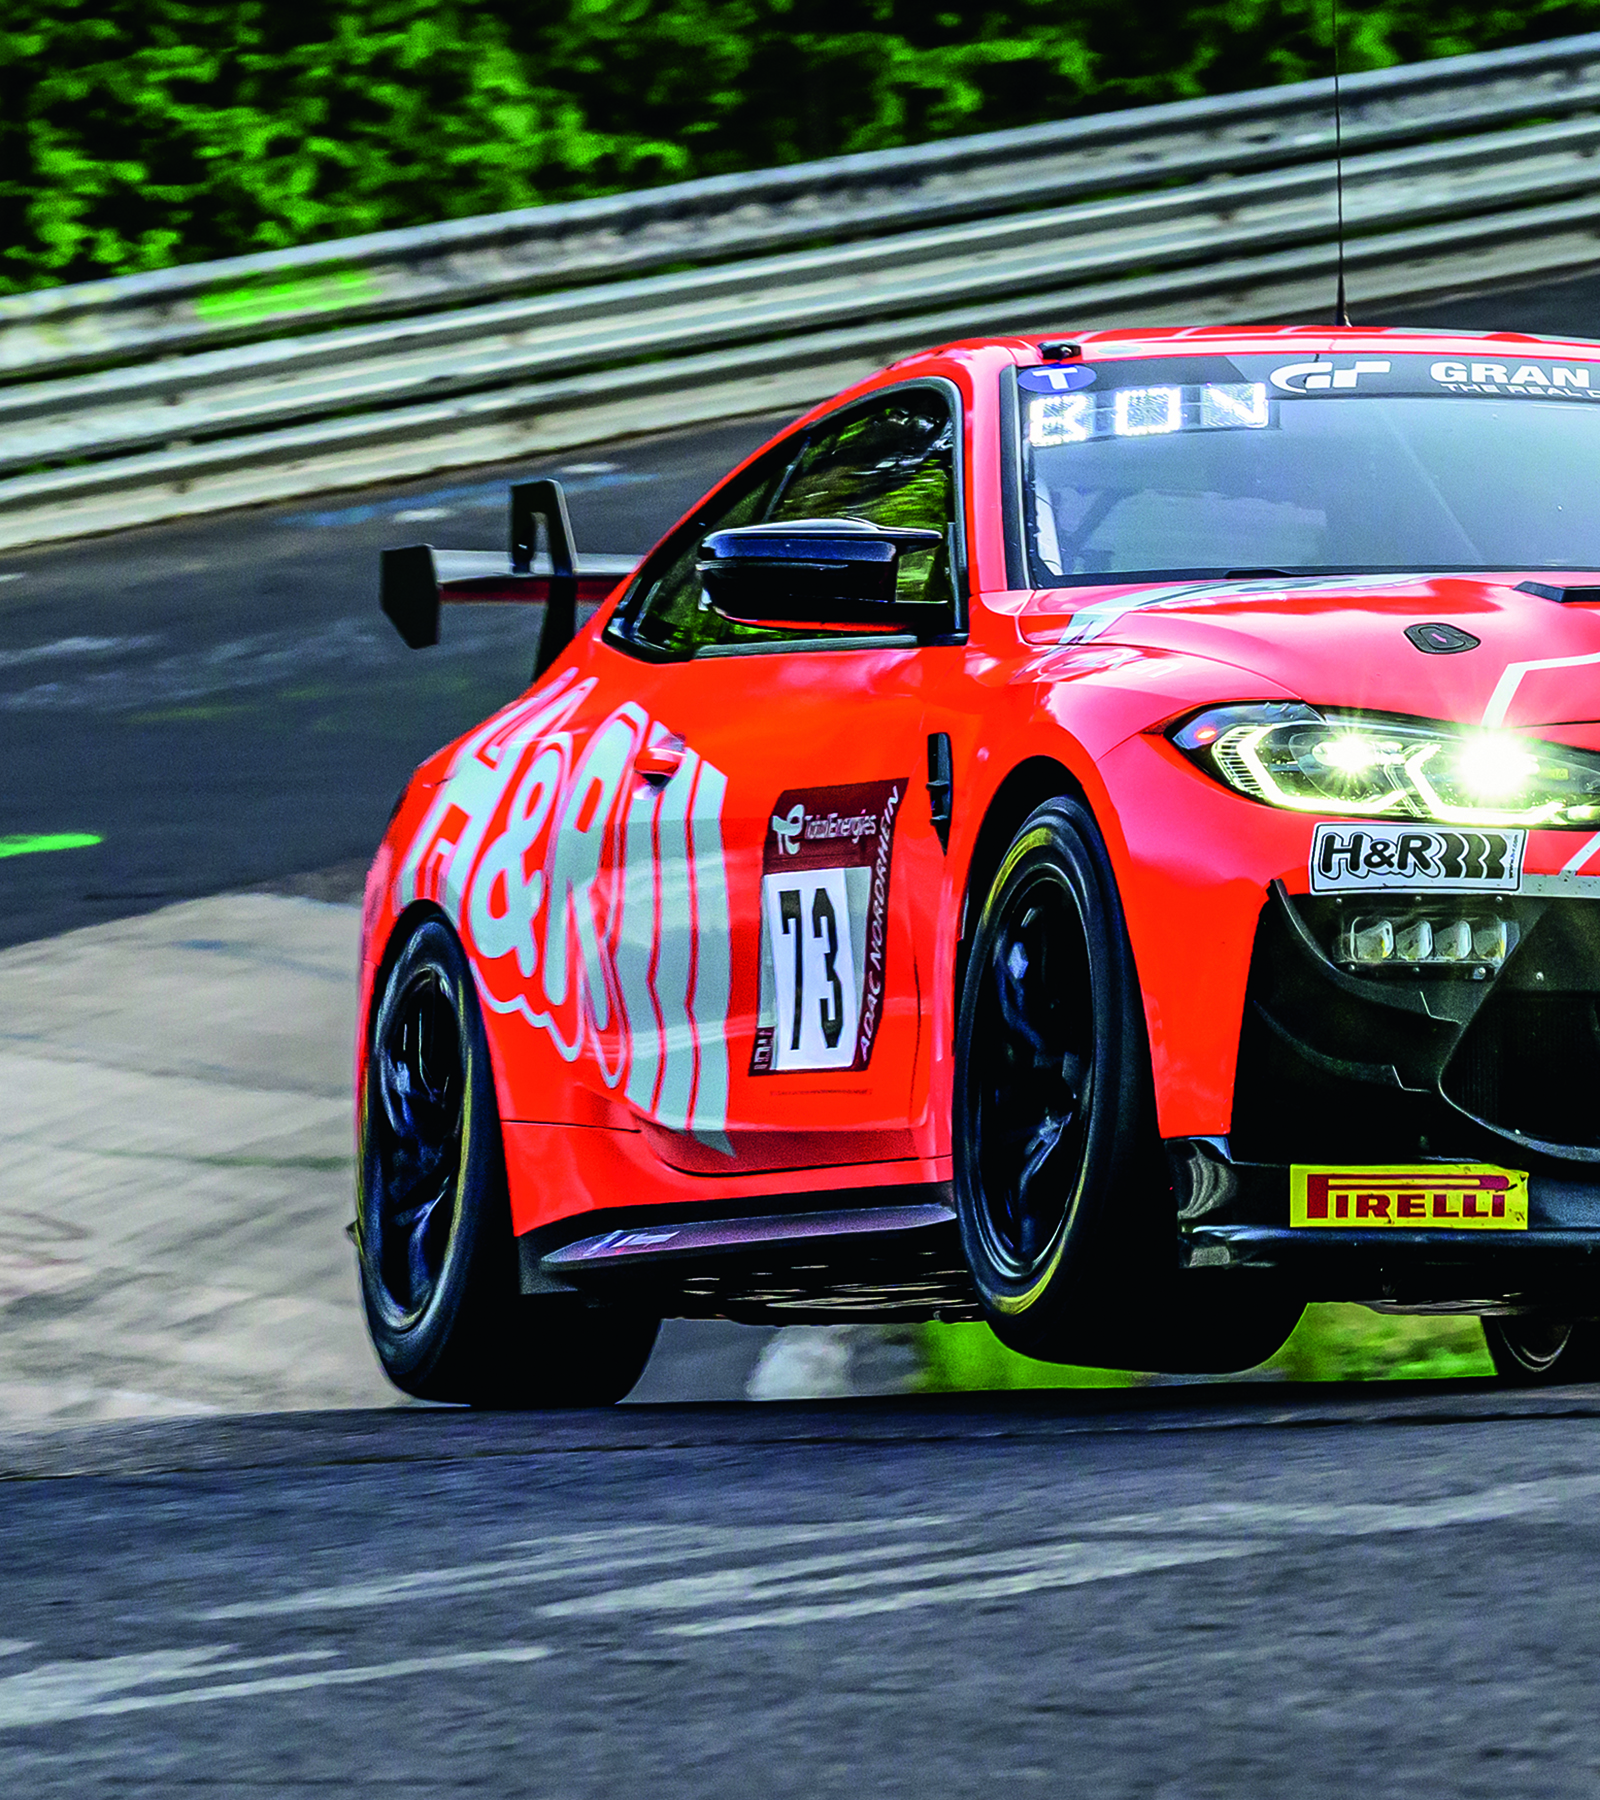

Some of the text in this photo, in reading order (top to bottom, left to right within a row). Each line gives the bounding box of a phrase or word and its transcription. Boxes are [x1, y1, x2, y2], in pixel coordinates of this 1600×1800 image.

[1430, 361, 1590, 388] GRAN
[1440, 383, 1500, 393] THE
[1506, 385, 1583, 397] REAL
[1320, 832, 1438, 878] H&R
[860, 785, 899, 1061] ADAC NORDRHEIN
[778, 887, 844, 1050] 73
[1306, 1173, 1510, 1219] PIRELLI
